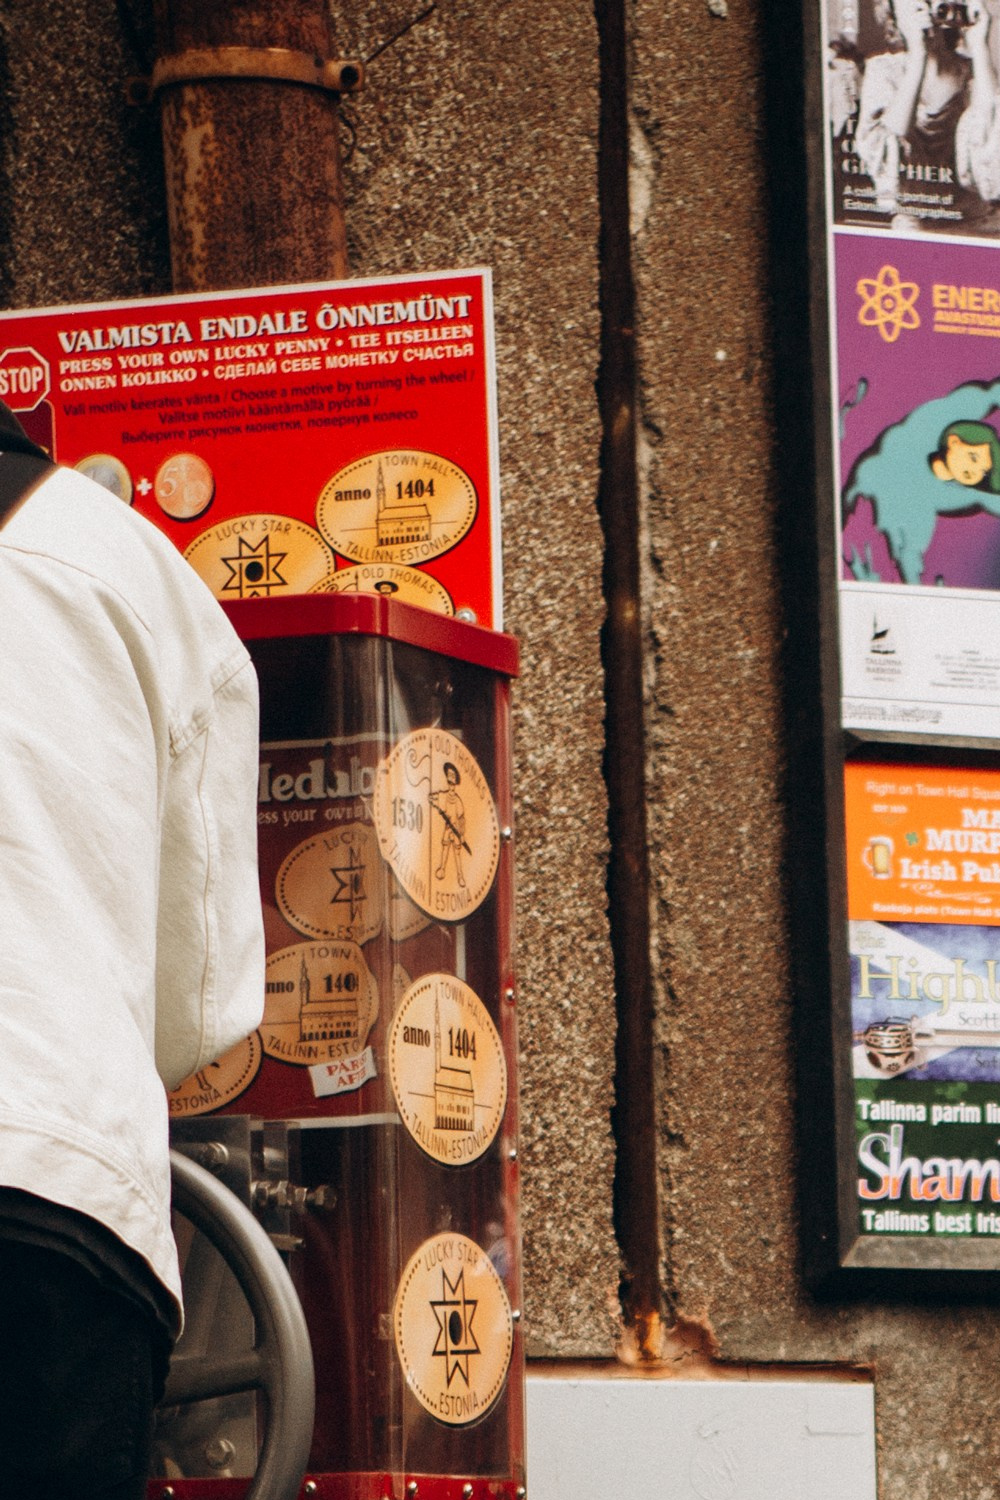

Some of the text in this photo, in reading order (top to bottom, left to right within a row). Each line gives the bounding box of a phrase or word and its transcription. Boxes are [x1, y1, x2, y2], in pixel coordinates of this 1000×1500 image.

[58, 294, 472, 353] VALMISTA ENDALE ÕNNEMÜNT
[59, 324, 474, 375] PRESS YOUR OWN LUCKY PENNY TEE ITSELLEEN
[214, 343, 474, 380] СДЕЛАЙ СЕБЕ МОНЕТКУ СЧАСТЬЯ
[0, 366, 44, 395] STOP
[60, 367, 197, 393] ONNEN KOLIKKO
[63, 369, 468, 417] Vali motiiv keerates vänta Choose a motive by turning the wheel
[158, 396, 371, 427] Valitse motiivi kääntämällä pyörää
[121, 408, 419, 447] Выберите рисунок монетки, повернув колесо
[385, 454, 451, 477] TOWN HALL
[334, 478, 436, 502] anno 1404
[214, 518, 293, 542] LUCKY STAR
[345, 533, 454, 563] TALLINN-ESTONIA
[361, 566, 437, 596] OLD THOMAS
[433, 733, 451, 755] OLD
[866, 780, 897, 797] Right
[899, 784, 913, 794] on
[916, 783, 945, 797] Town
[948, 786, 969, 798] Hall
[283, 808, 318, 828] your
[391, 797, 425, 834] 1530
[900, 858, 957, 882] Irish
[434, 888, 475, 914] ESTONIA
[439, 981, 464, 1005] TOWN
[402, 1024, 478, 1062] anno 1404
[859, 1099, 926, 1122] Tallinna
[931, 1102, 981, 1126] parim
[410, 1113, 491, 1158] TALLINN-ESTONIA
[862, 1210, 929, 1233] Tallinns
[935, 1211, 972, 1234] best
[424, 1241, 481, 1273] LUCKY STAR
[438, 1391, 480, 1417] ESTONIA
